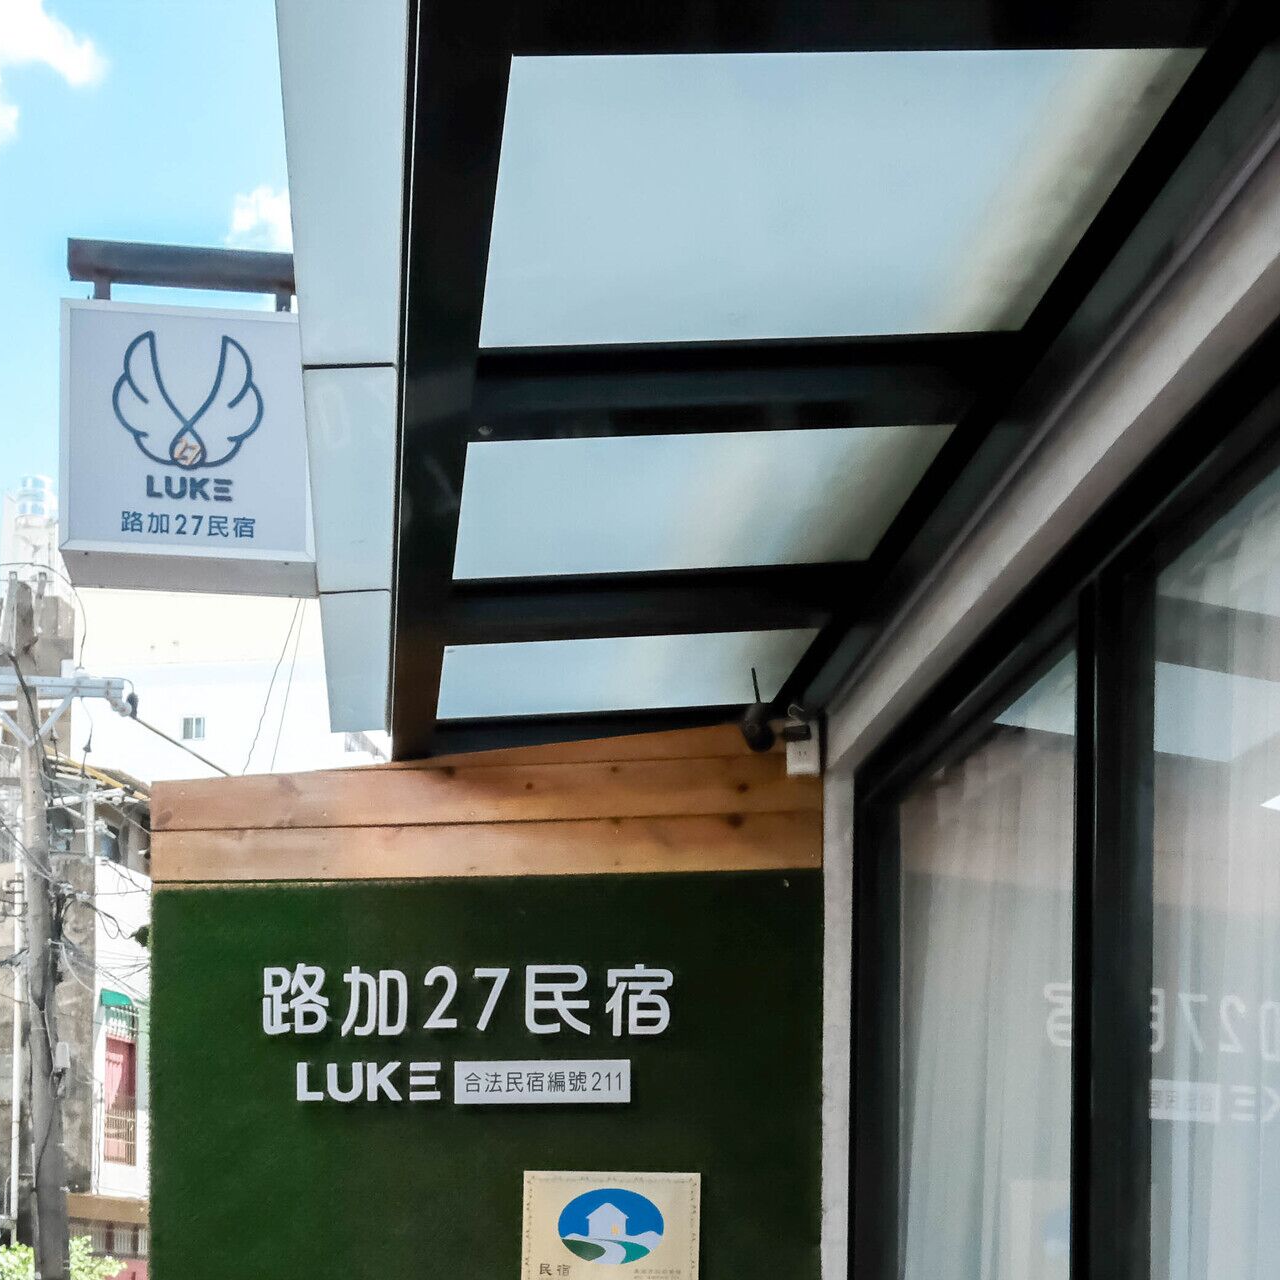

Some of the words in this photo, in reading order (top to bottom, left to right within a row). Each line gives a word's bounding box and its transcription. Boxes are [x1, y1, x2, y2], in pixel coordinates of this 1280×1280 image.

[146, 474, 233, 501] LUKE
[120, 510, 256, 539] 路加27民宿
[261, 962, 675, 1037] 路加27民宿
[296, 1060, 442, 1102] LUKE
[463, 1070, 623, 1094] 合法民宿編號211
[539, 1262, 571, 1277] 民宿
